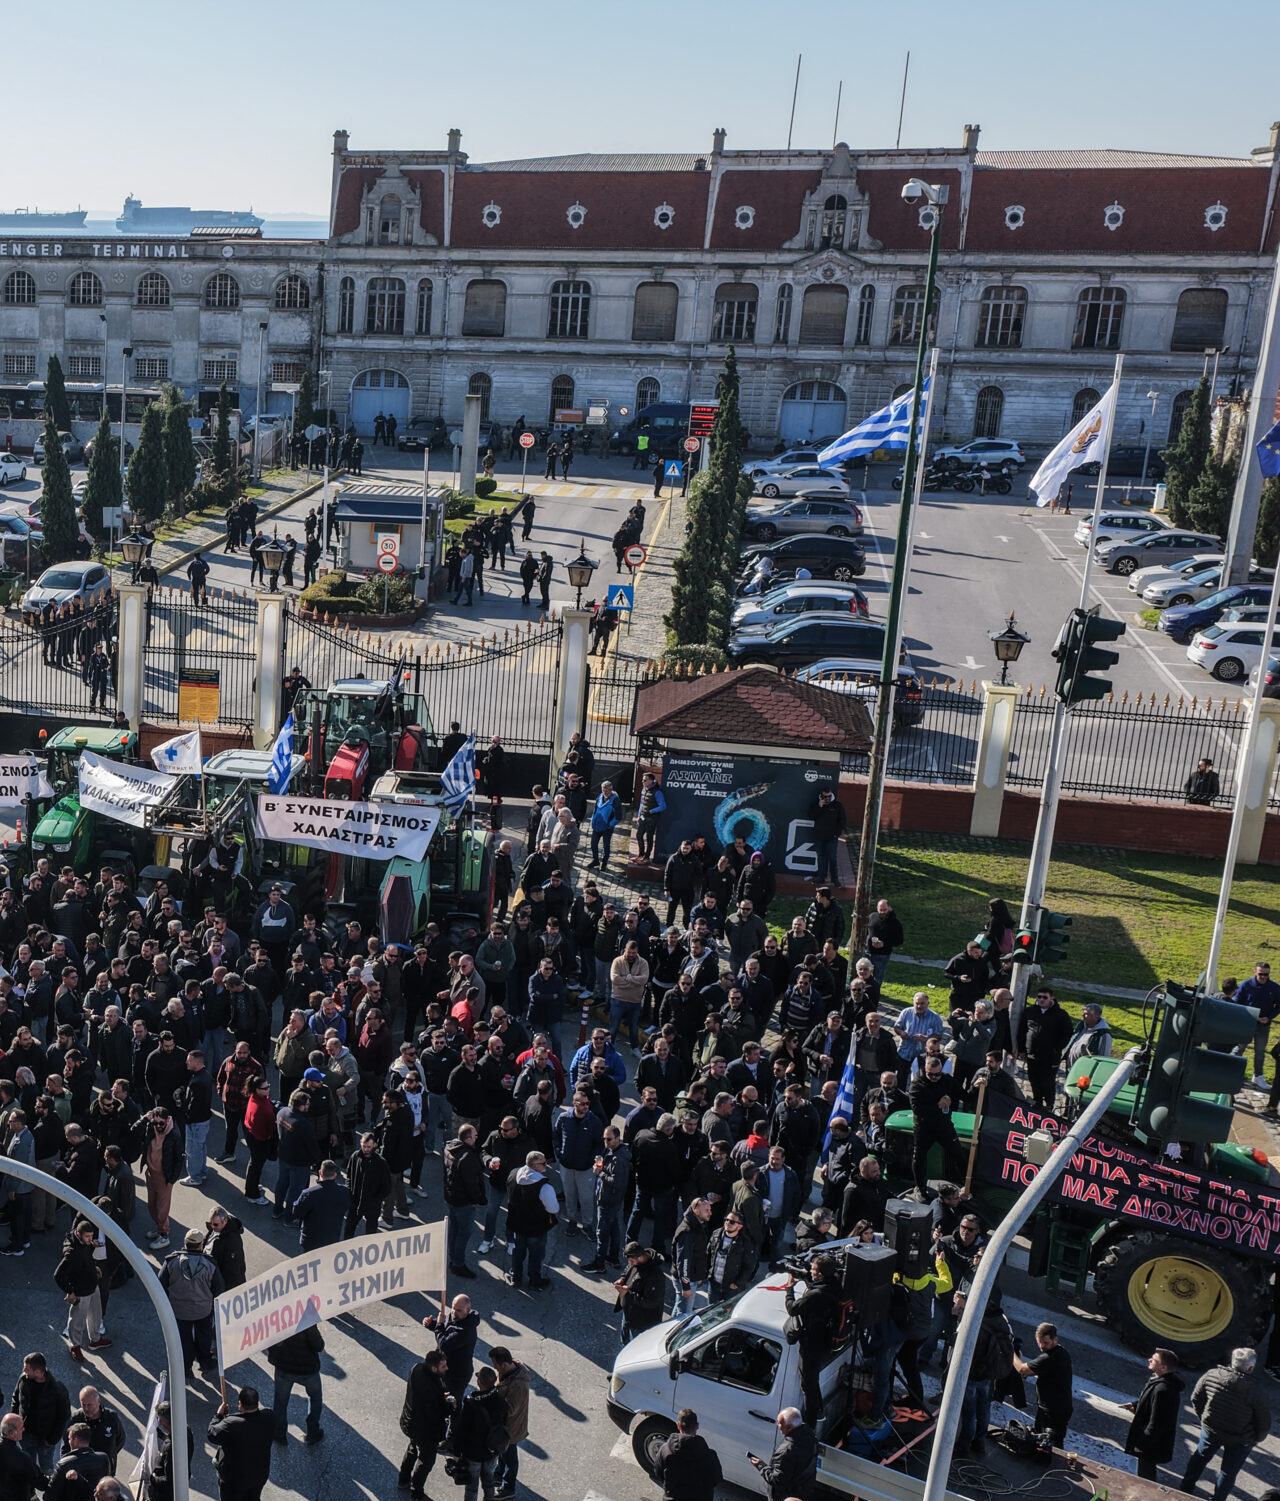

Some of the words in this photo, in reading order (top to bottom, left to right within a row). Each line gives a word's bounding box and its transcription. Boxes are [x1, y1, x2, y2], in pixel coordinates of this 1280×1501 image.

[93, 244, 189, 258] TERMINAL
[685, 441, 699, 449] STOP
[667, 770, 733, 784] ΛΙΜΑΝΙ
[669, 758, 735, 768] ΔΗΜΙΟΥΡΓΟΥΜΕ
[82, 783, 144, 813] ΧΑΛΑΣΤΡΑΣ
[285, 802, 432, 832] ΣΥΝΕΤΑΙΡΙΣΜΟΣ
[293, 821, 398, 849] ΧΑΛΑΣΤΡΑΣ
[1138, 1173, 1200, 1205] ΣΤΙΣ
[1062, 1174, 1119, 1210] ΜΑΣ
[1122, 1195, 1271, 1251] ΔΙΩΧΝΟΥΝ
